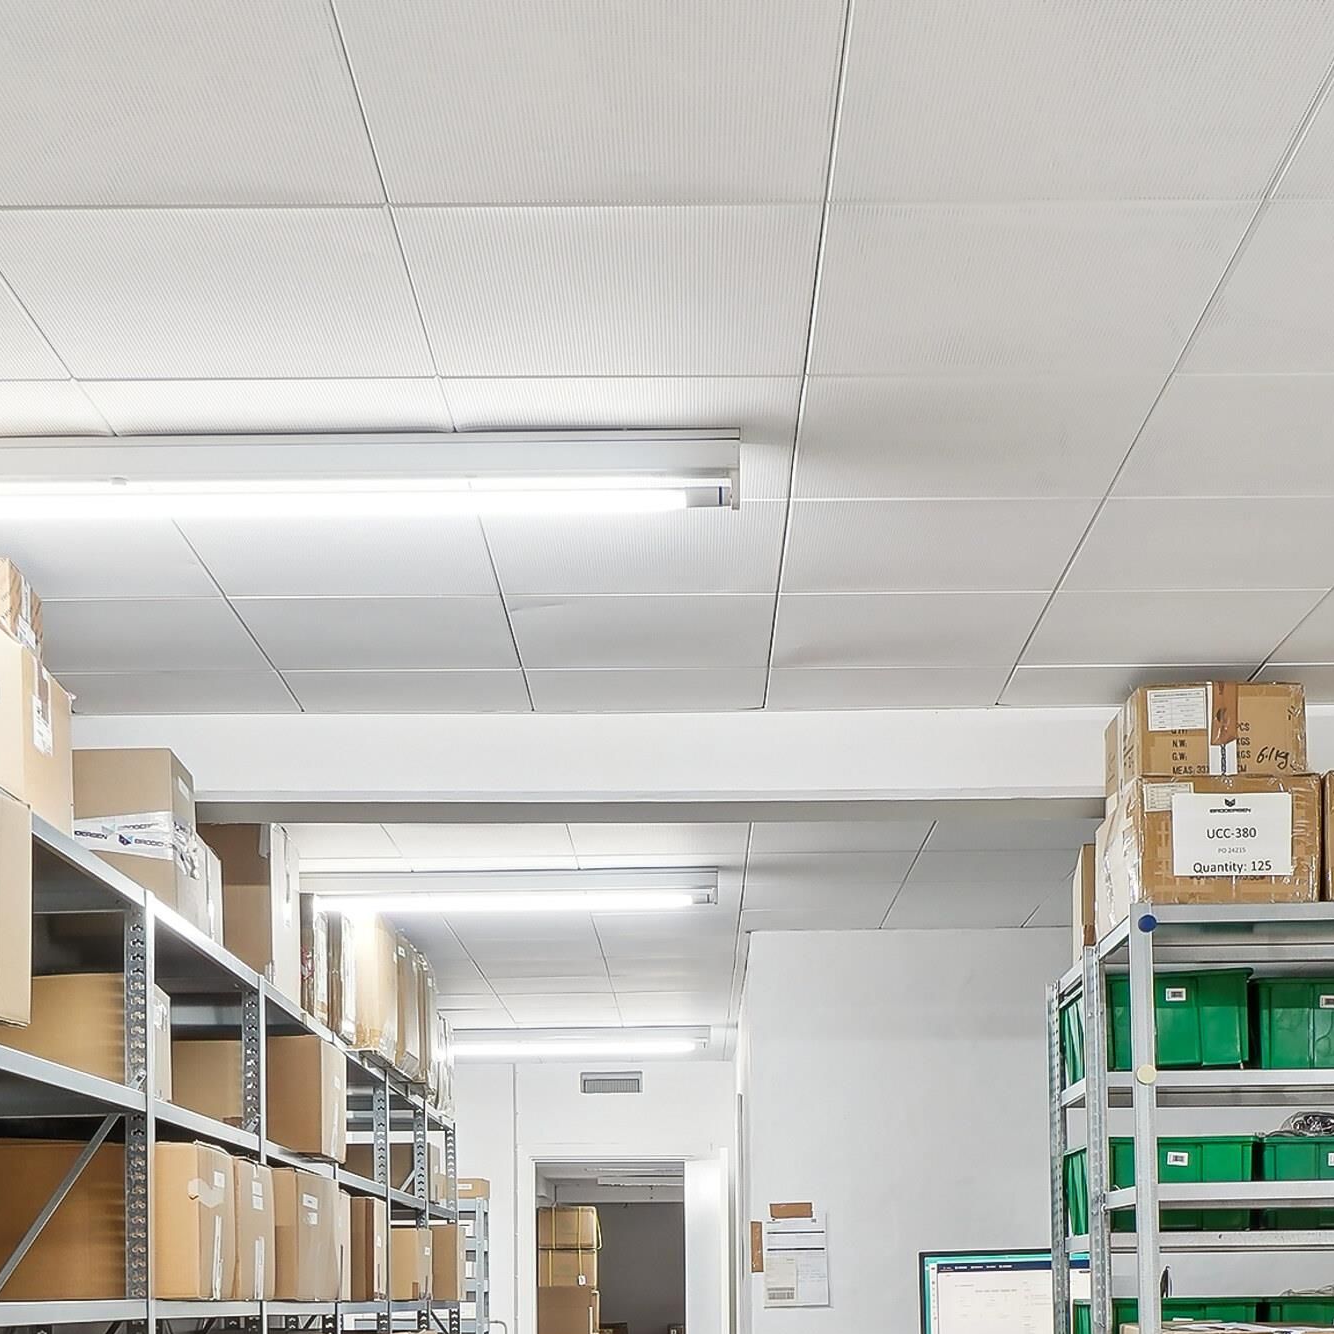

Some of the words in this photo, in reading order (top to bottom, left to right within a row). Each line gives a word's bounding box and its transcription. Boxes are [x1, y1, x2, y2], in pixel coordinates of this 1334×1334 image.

[1207, 827, 1257, 839] UCC-380
[1193, 861, 1247, 873] Quantity:
[1251, 860, 1272, 872] 125
